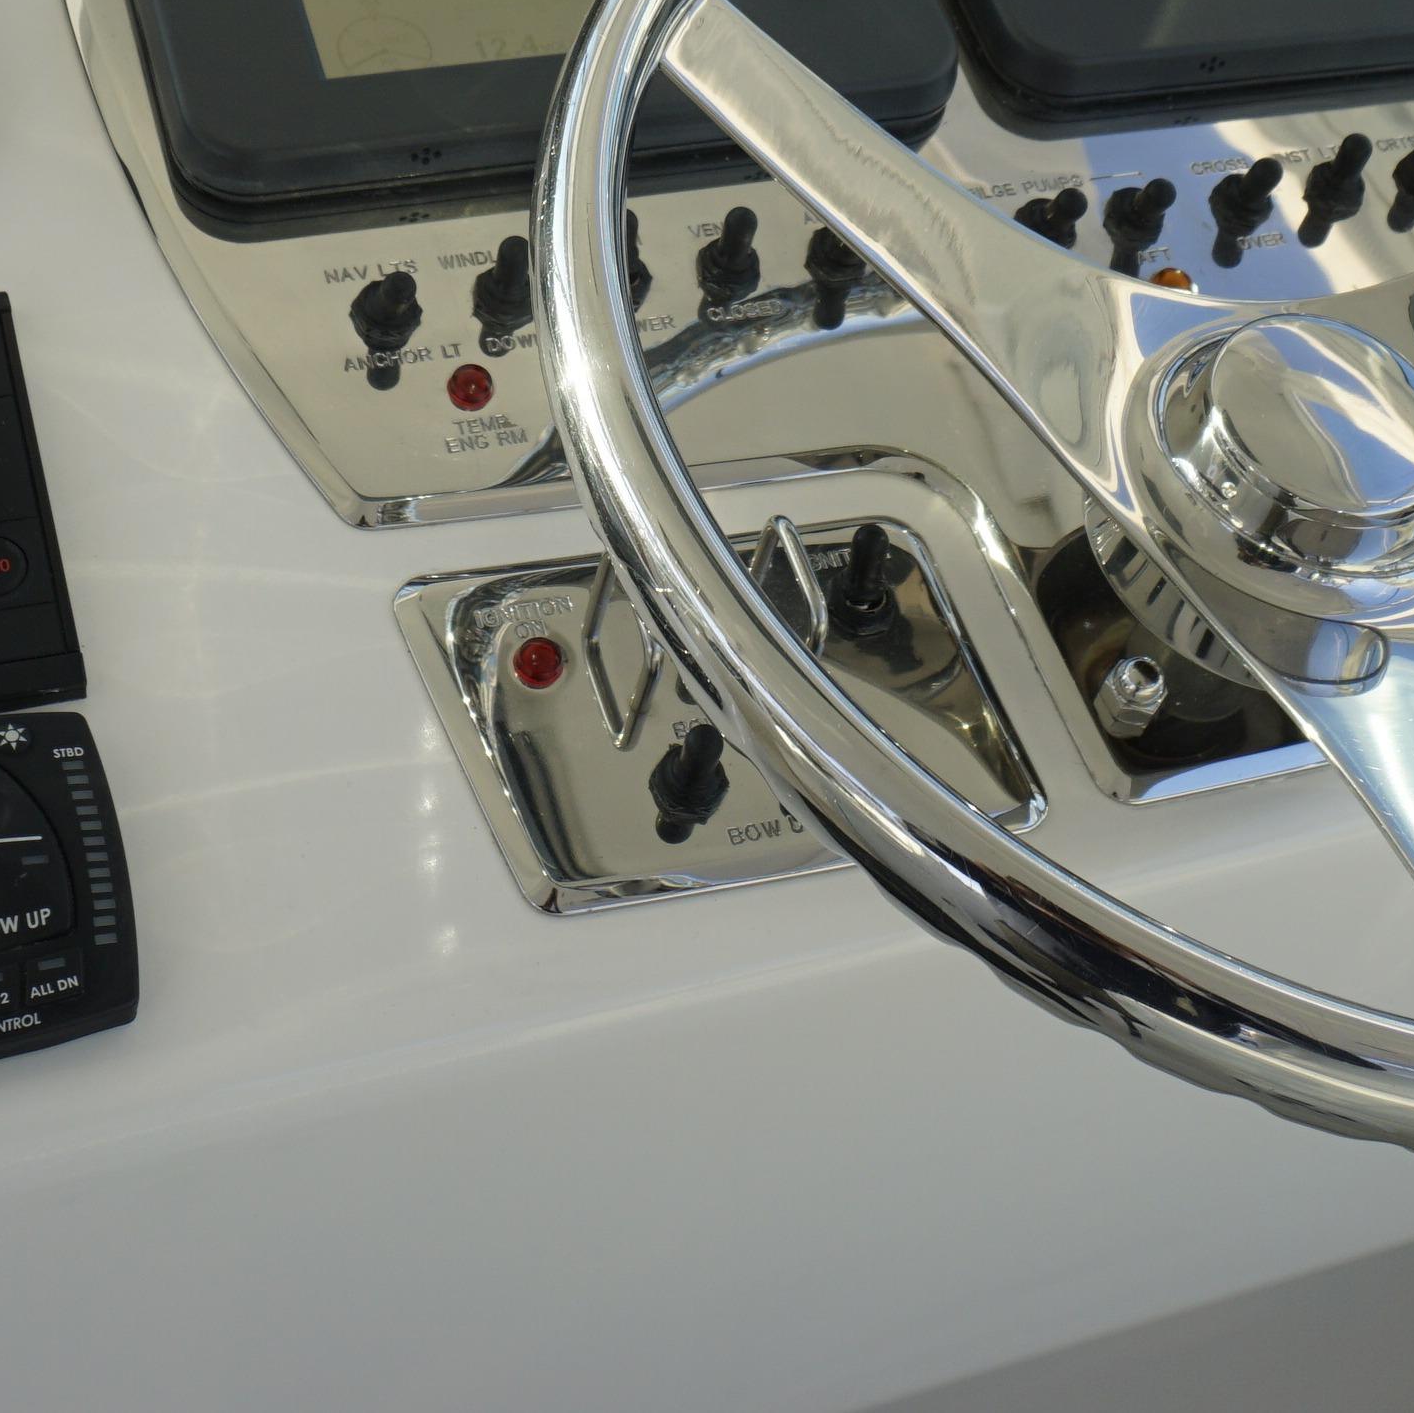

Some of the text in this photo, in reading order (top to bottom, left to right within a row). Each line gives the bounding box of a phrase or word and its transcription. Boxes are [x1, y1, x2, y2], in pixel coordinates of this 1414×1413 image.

[1191, 157, 1249, 176] CROSS
[1023, 174, 1084, 195] PUMPS
[687, 222, 724, 238] VEN
[1137, 247, 1171, 265] AFT
[324, 266, 368, 284] NAV
[706, 299, 785, 322] CLOSED
[485, 333, 538, 353] DOW
[344, 343, 463, 372] ANCHOR LT
[445, 430, 528, 454] ENG RM
[474, 594, 573, 629] IGNITION
[515, 619, 548, 639] ON
[52, 747, 84, 759] STBD
[727, 819, 781, 845] BOW
[26, 908, 52, 930] UP
[30, 975, 79, 999] ALL DN
